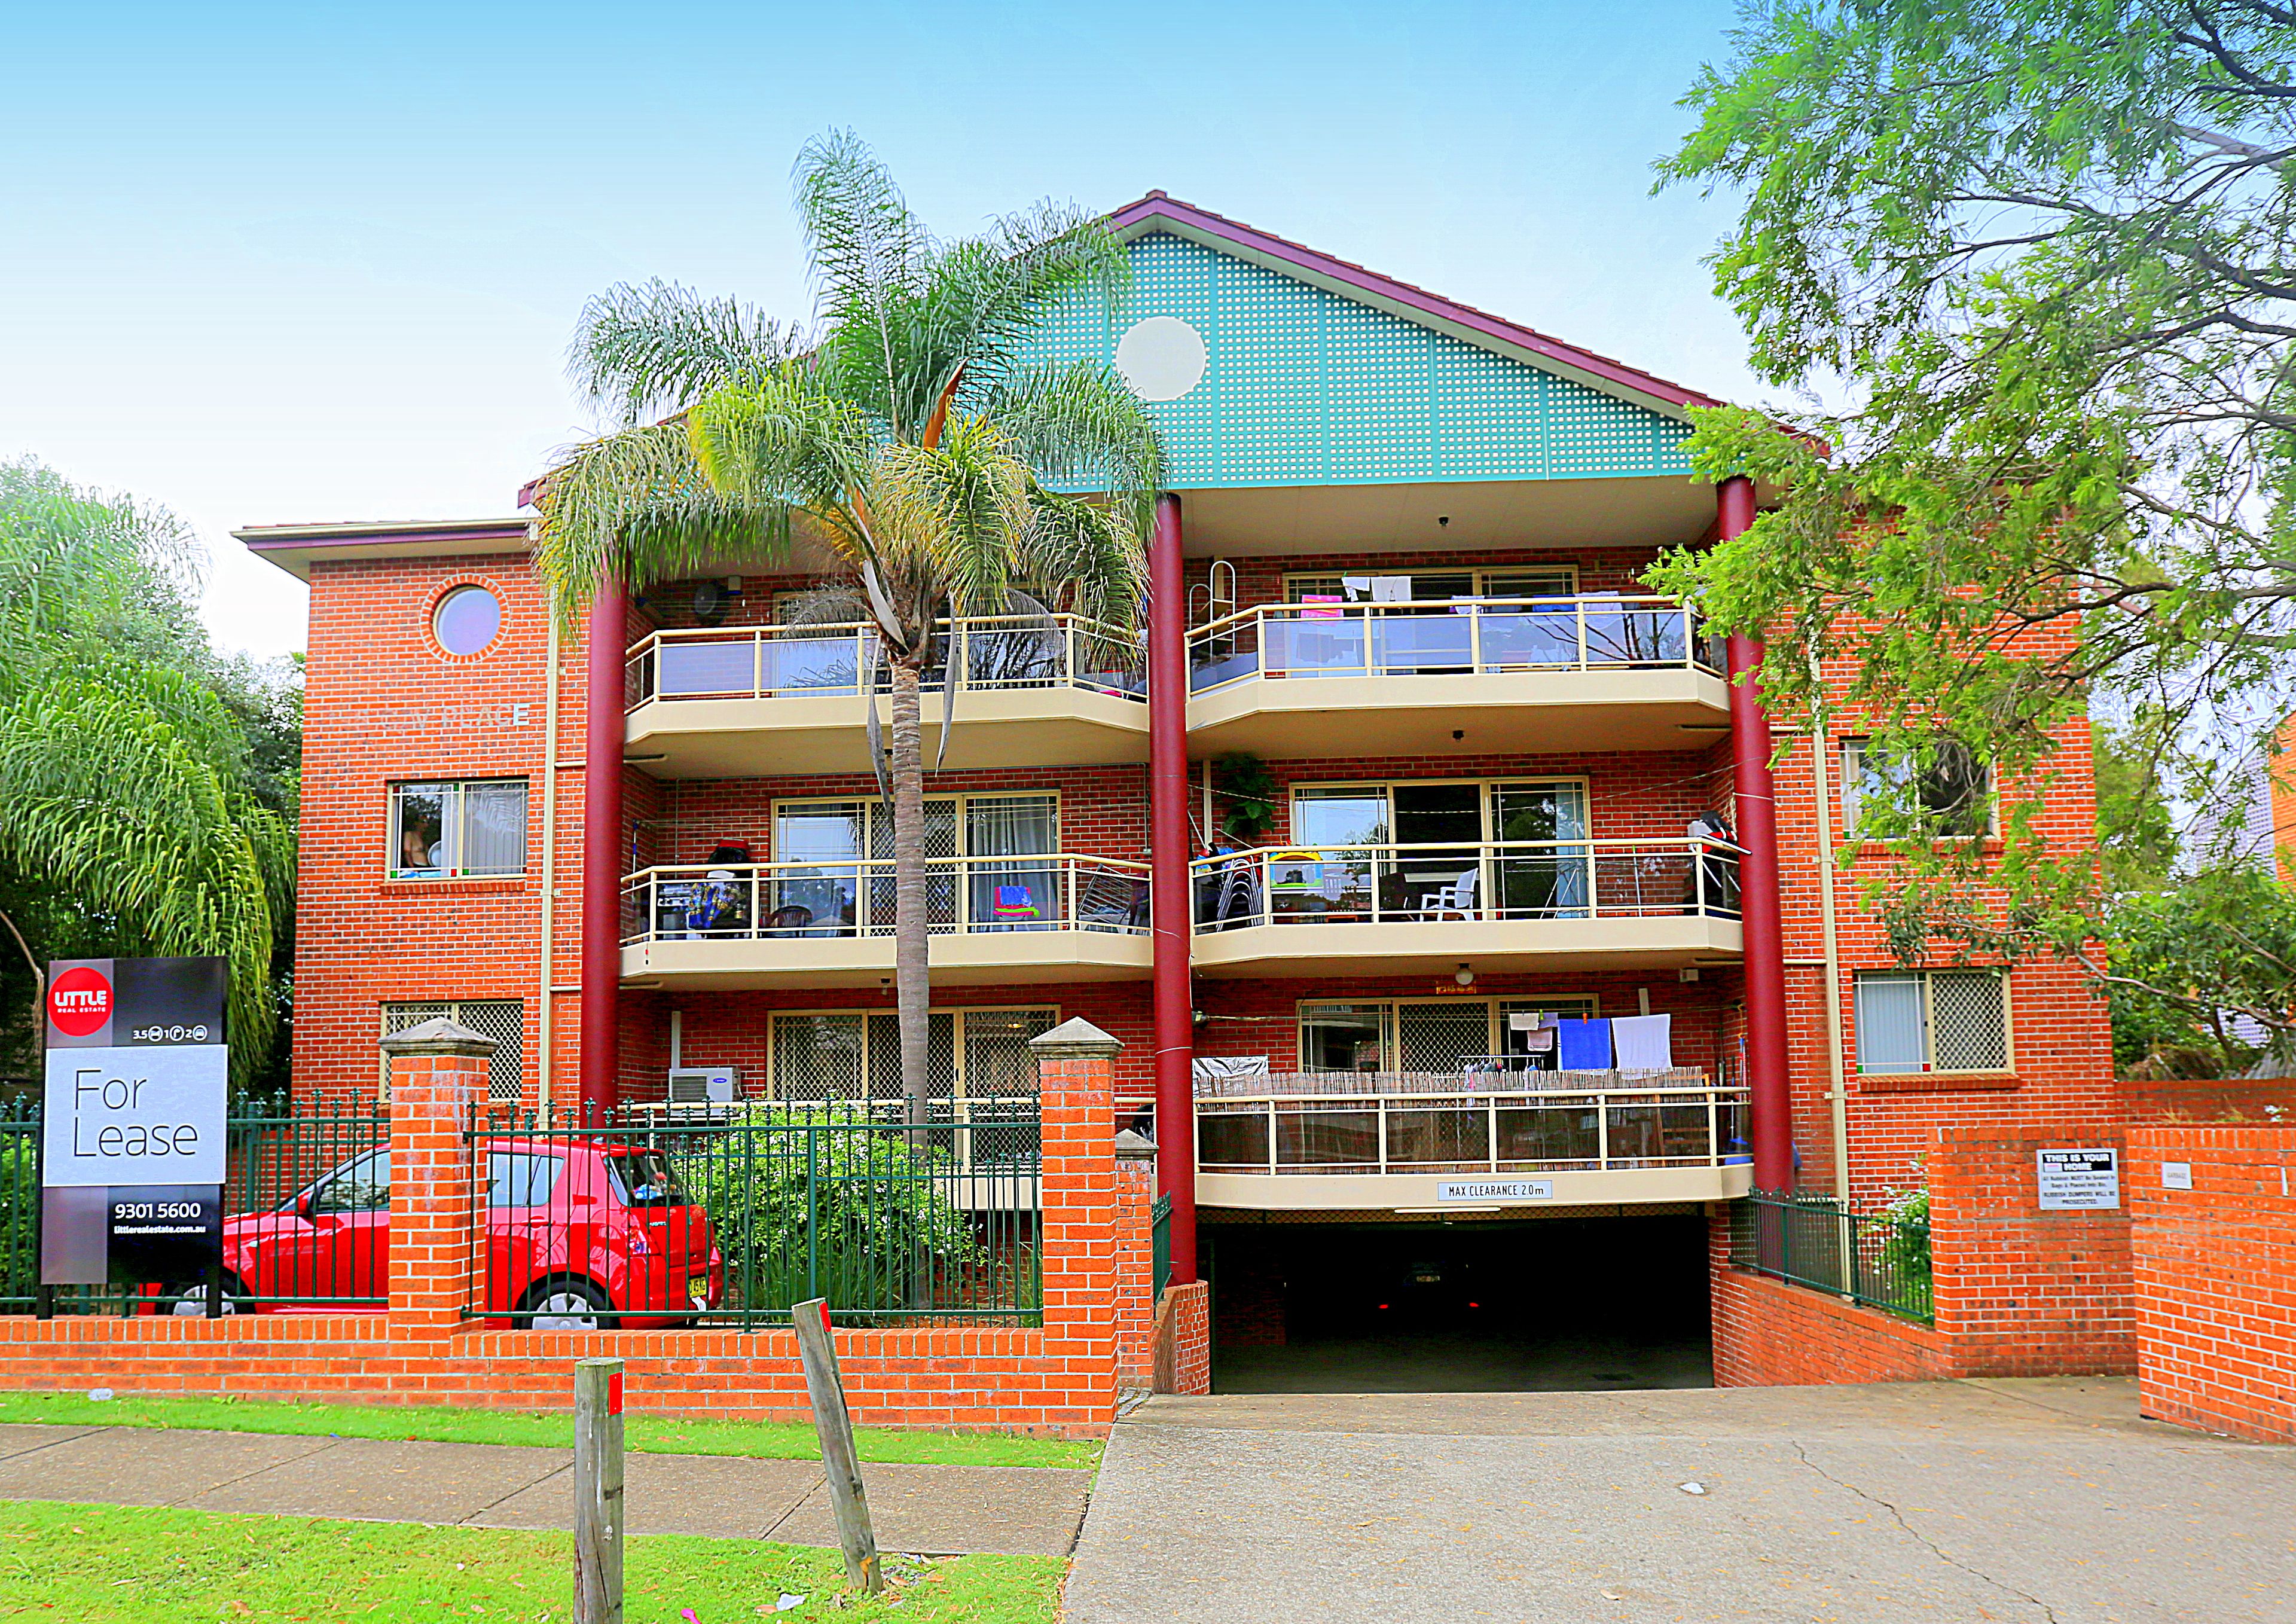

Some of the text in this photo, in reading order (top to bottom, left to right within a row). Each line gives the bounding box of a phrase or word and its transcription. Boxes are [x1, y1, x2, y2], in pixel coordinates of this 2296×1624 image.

[54, 990, 107, 1006] LITTLE
[164, 1030, 169, 1039] 1
[185, 1029, 193, 1039] 2
[75, 1069, 147, 1110] For
[74, 1116, 198, 1157] Lease
[2044, 1153, 2110, 1162] THIS IS YOUR
[2063, 1162, 2092, 1171] HOME
[1449, 1186, 1466, 1196] MAX
[1469, 1185, 1518, 1196] CLEARANCE
[115, 1202, 201, 1219] 9301 5600
[114, 1225, 206, 1234] littlerealestate.com.au
